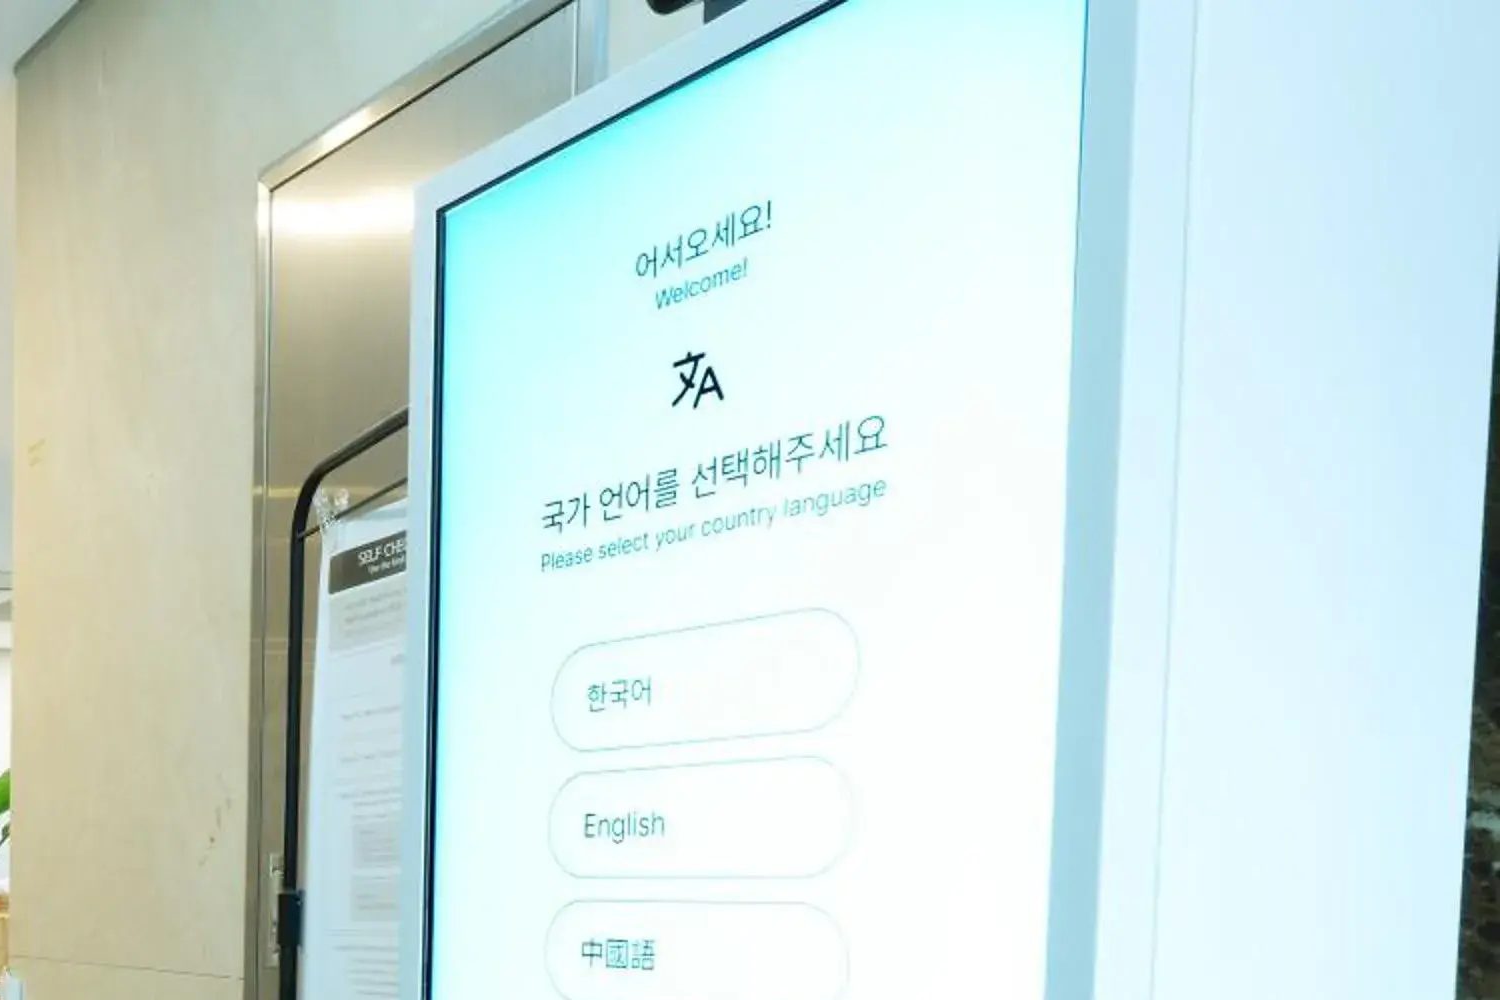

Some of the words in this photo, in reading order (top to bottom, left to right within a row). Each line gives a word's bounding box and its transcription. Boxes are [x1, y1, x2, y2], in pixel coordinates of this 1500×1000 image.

[635, 199, 771, 279] 어서오세요!
[655, 256, 748, 310] Welcome!
[541, 491, 591, 534] 국가
[599, 467, 681, 522] 언어를
[691, 415, 888, 499] 선택해주세요
[541, 546, 593, 573] Please
[598, 532, 649, 560] select
[655, 522, 695, 552] your
[701, 506, 776, 538] country
[784, 479, 887, 520] language
[587, 675, 652, 713] 한국어
[584, 806, 665, 844] English
[581, 937, 656, 970] 中國語
